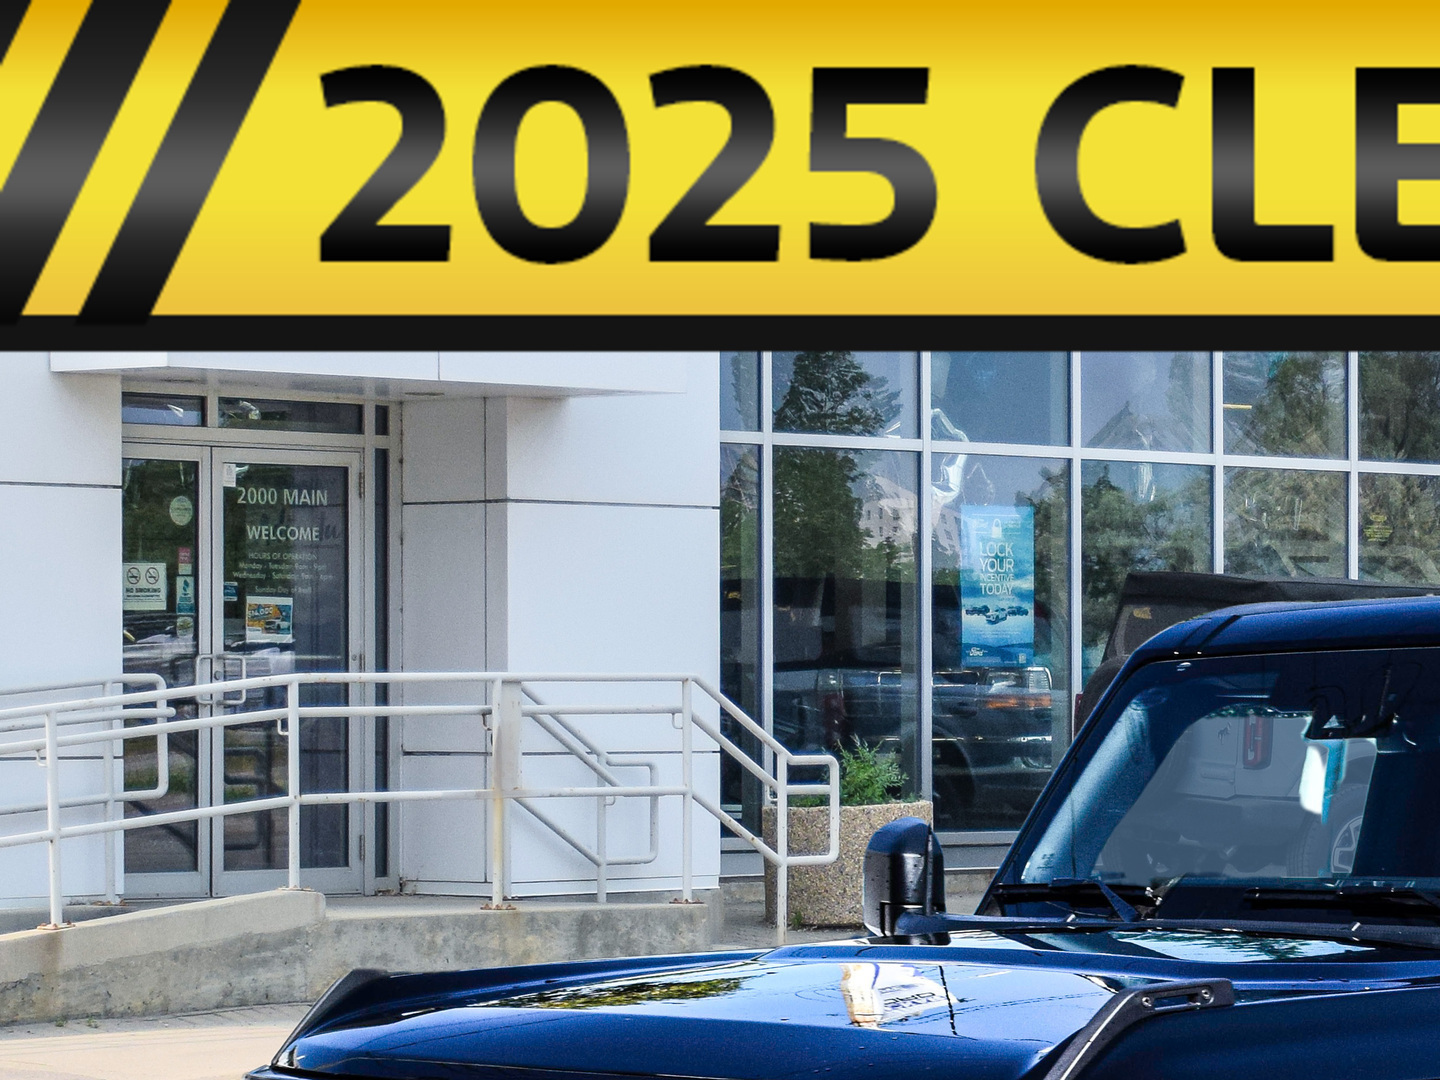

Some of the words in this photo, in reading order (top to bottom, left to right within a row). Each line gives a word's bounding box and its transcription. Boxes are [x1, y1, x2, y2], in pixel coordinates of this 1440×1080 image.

[237, 487, 277, 504] 2000
[283, 489, 328, 506] MAIN
[246, 525, 320, 541] WELCOME
[979, 541, 1013, 557] LOCK
[249, 552, 271, 560] HOURS
[272, 552, 281, 560] OF
[282, 552, 318, 561] OPERATION
[979, 558, 1015, 573] YOUR
[232, 571, 267, 580] Wednesday
[981, 573, 1015, 583] INCENTIVE
[980, 583, 1014, 595] TODAY
